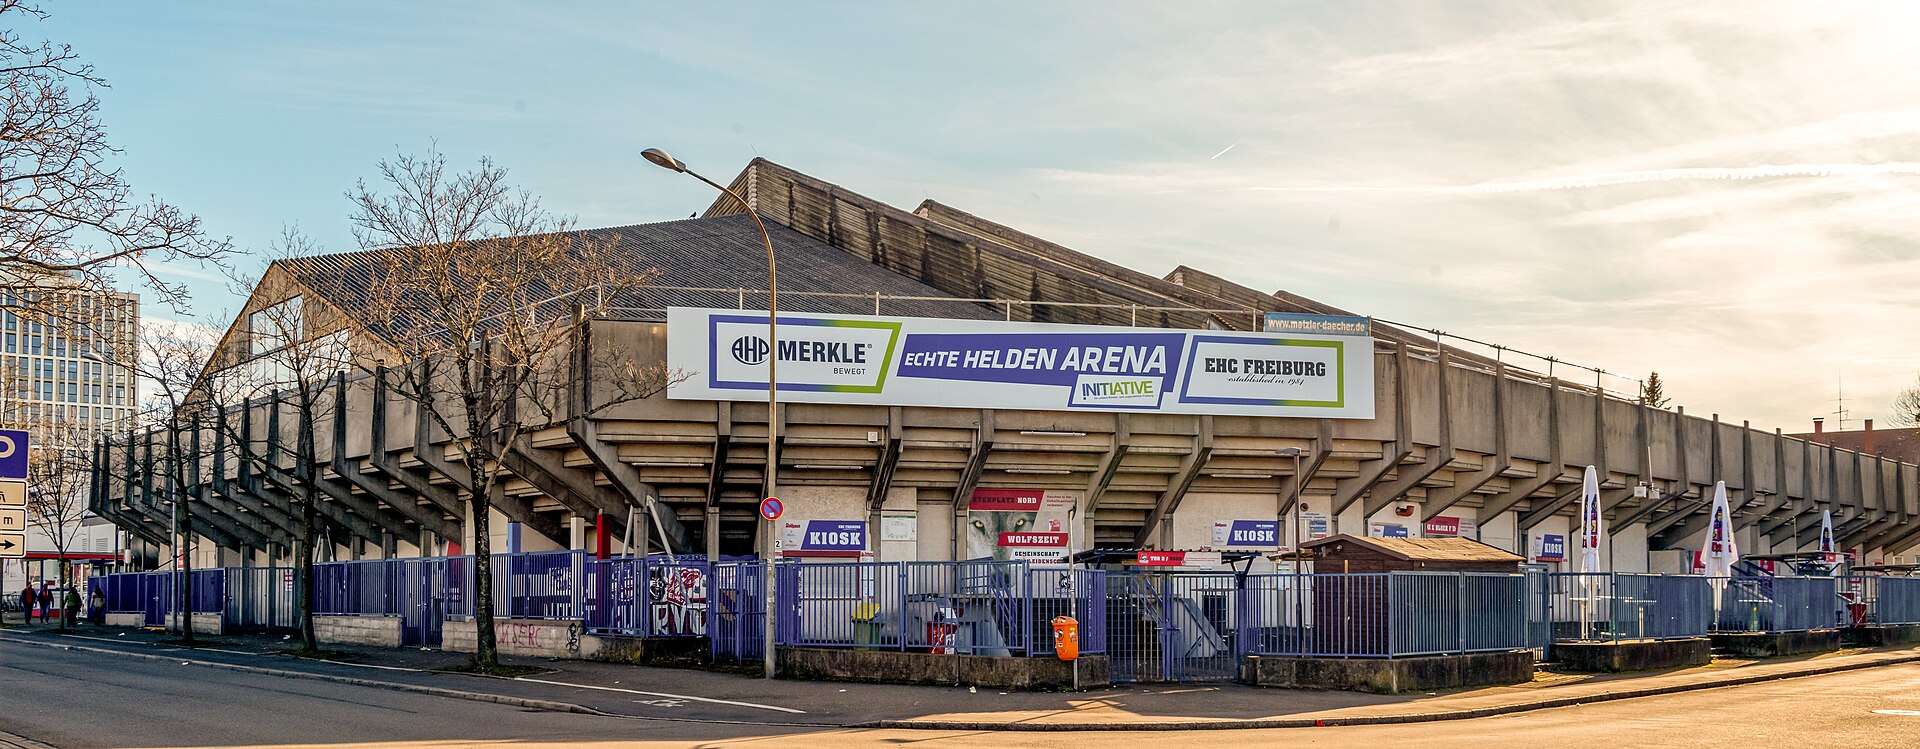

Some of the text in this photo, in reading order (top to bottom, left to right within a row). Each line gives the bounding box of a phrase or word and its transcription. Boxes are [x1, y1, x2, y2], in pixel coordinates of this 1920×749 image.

[1268, 318, 1365, 332] www.metzler-daecher.de
[731, 335, 770, 365] AHP
[904, 345, 1167, 374] ECHTE HELDEN ARENA
[833, 367, 866, 375] BEWEGT
[1205, 357, 1326, 377] EHC FREIBURG
[1226, 373, 1275, 384] established
[1275, 376, 1285, 385] in
[3, 516, 13, 525] m
[809, 532, 861, 545] KIOSK
[1007, 535, 1060, 543] WOLFSZEIT
[1234, 530, 1274, 541] KIOSK
[1544, 543, 1563, 554] KIOSK
